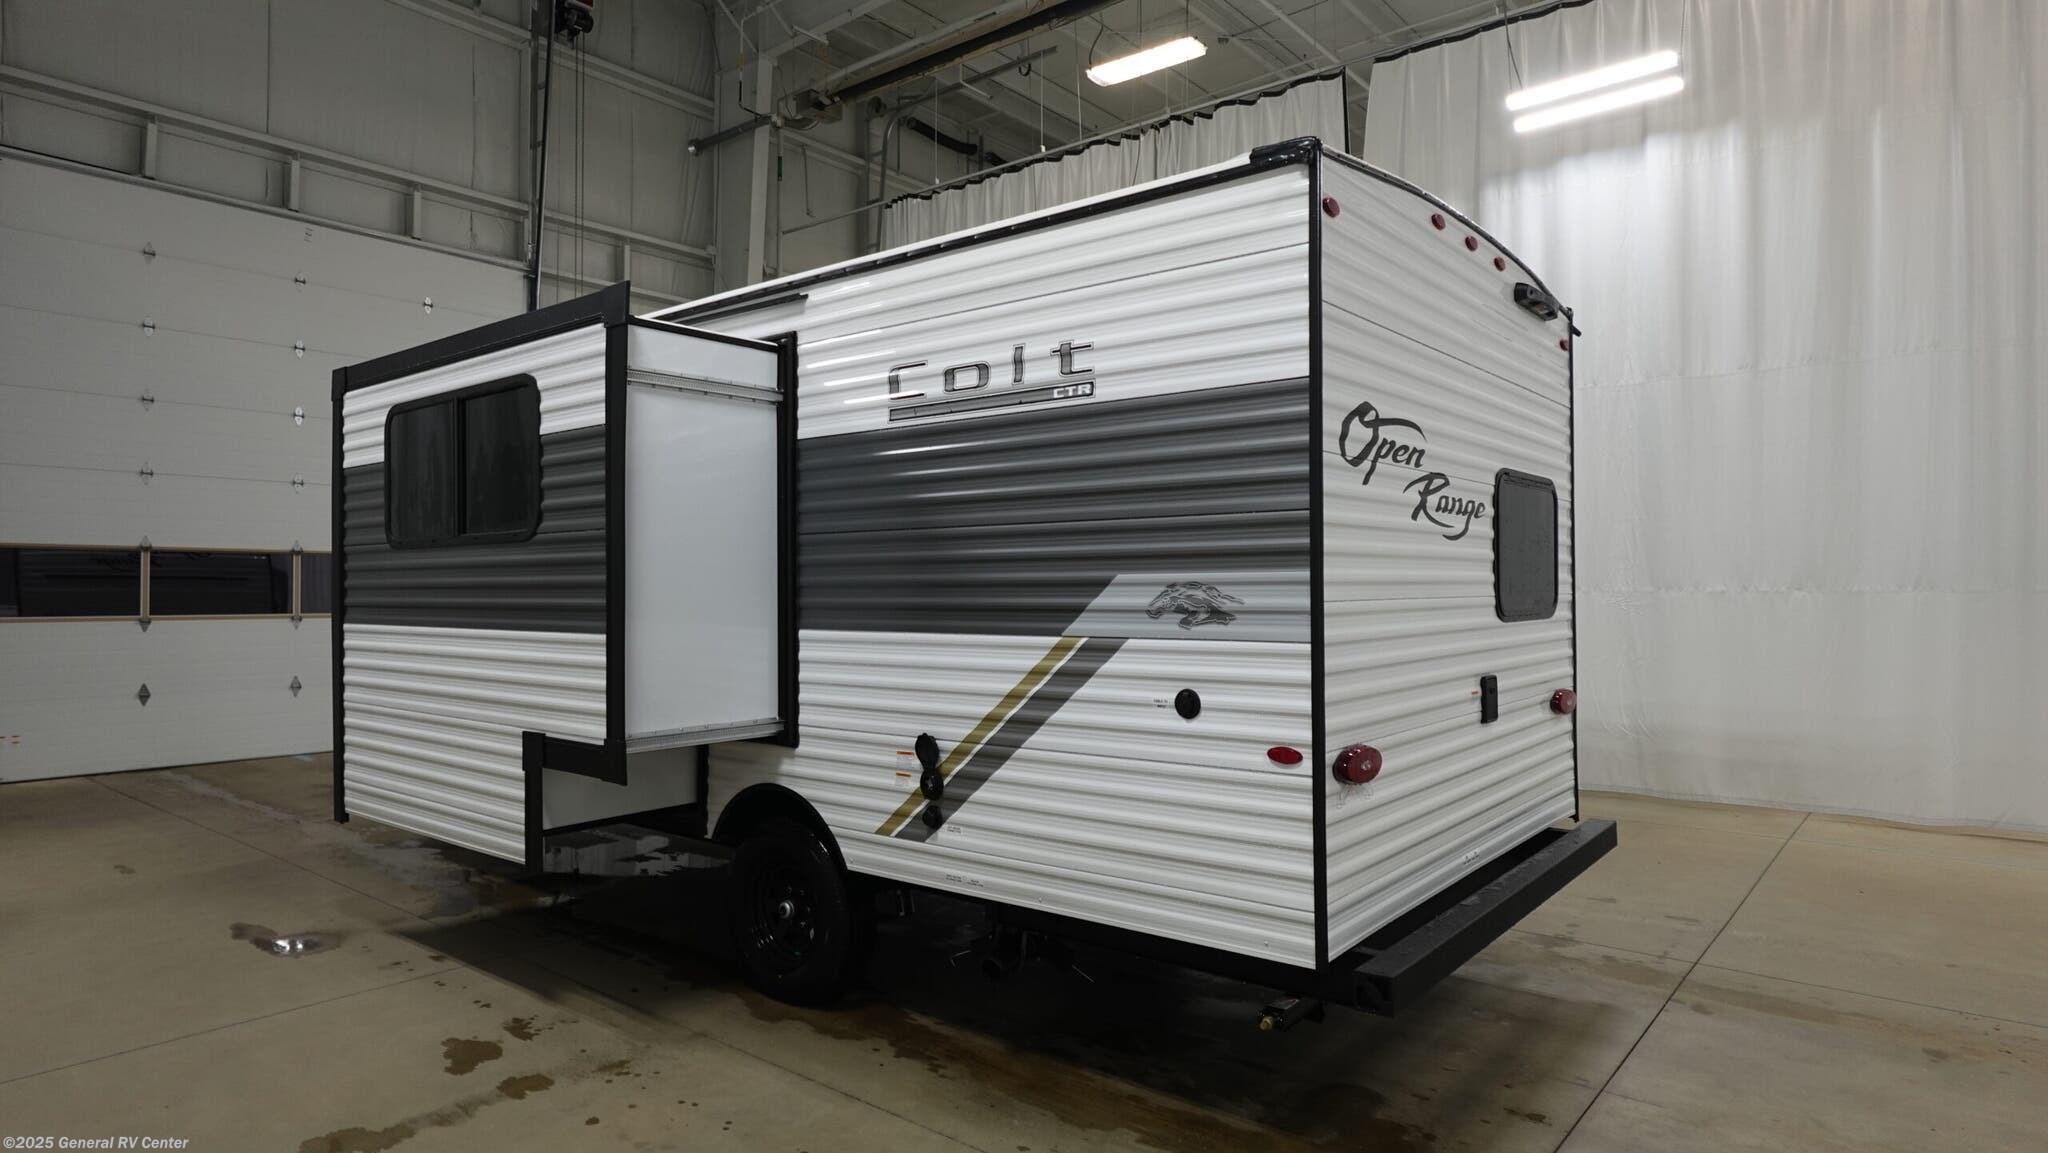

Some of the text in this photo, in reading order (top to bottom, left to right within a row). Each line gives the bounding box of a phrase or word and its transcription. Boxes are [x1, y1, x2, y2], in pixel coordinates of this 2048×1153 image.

[888, 339, 1095, 402] Colt
[1052, 383, 1092, 399] CTR
[1339, 401, 1426, 486] Open
[1402, 472, 1486, 541] Range
